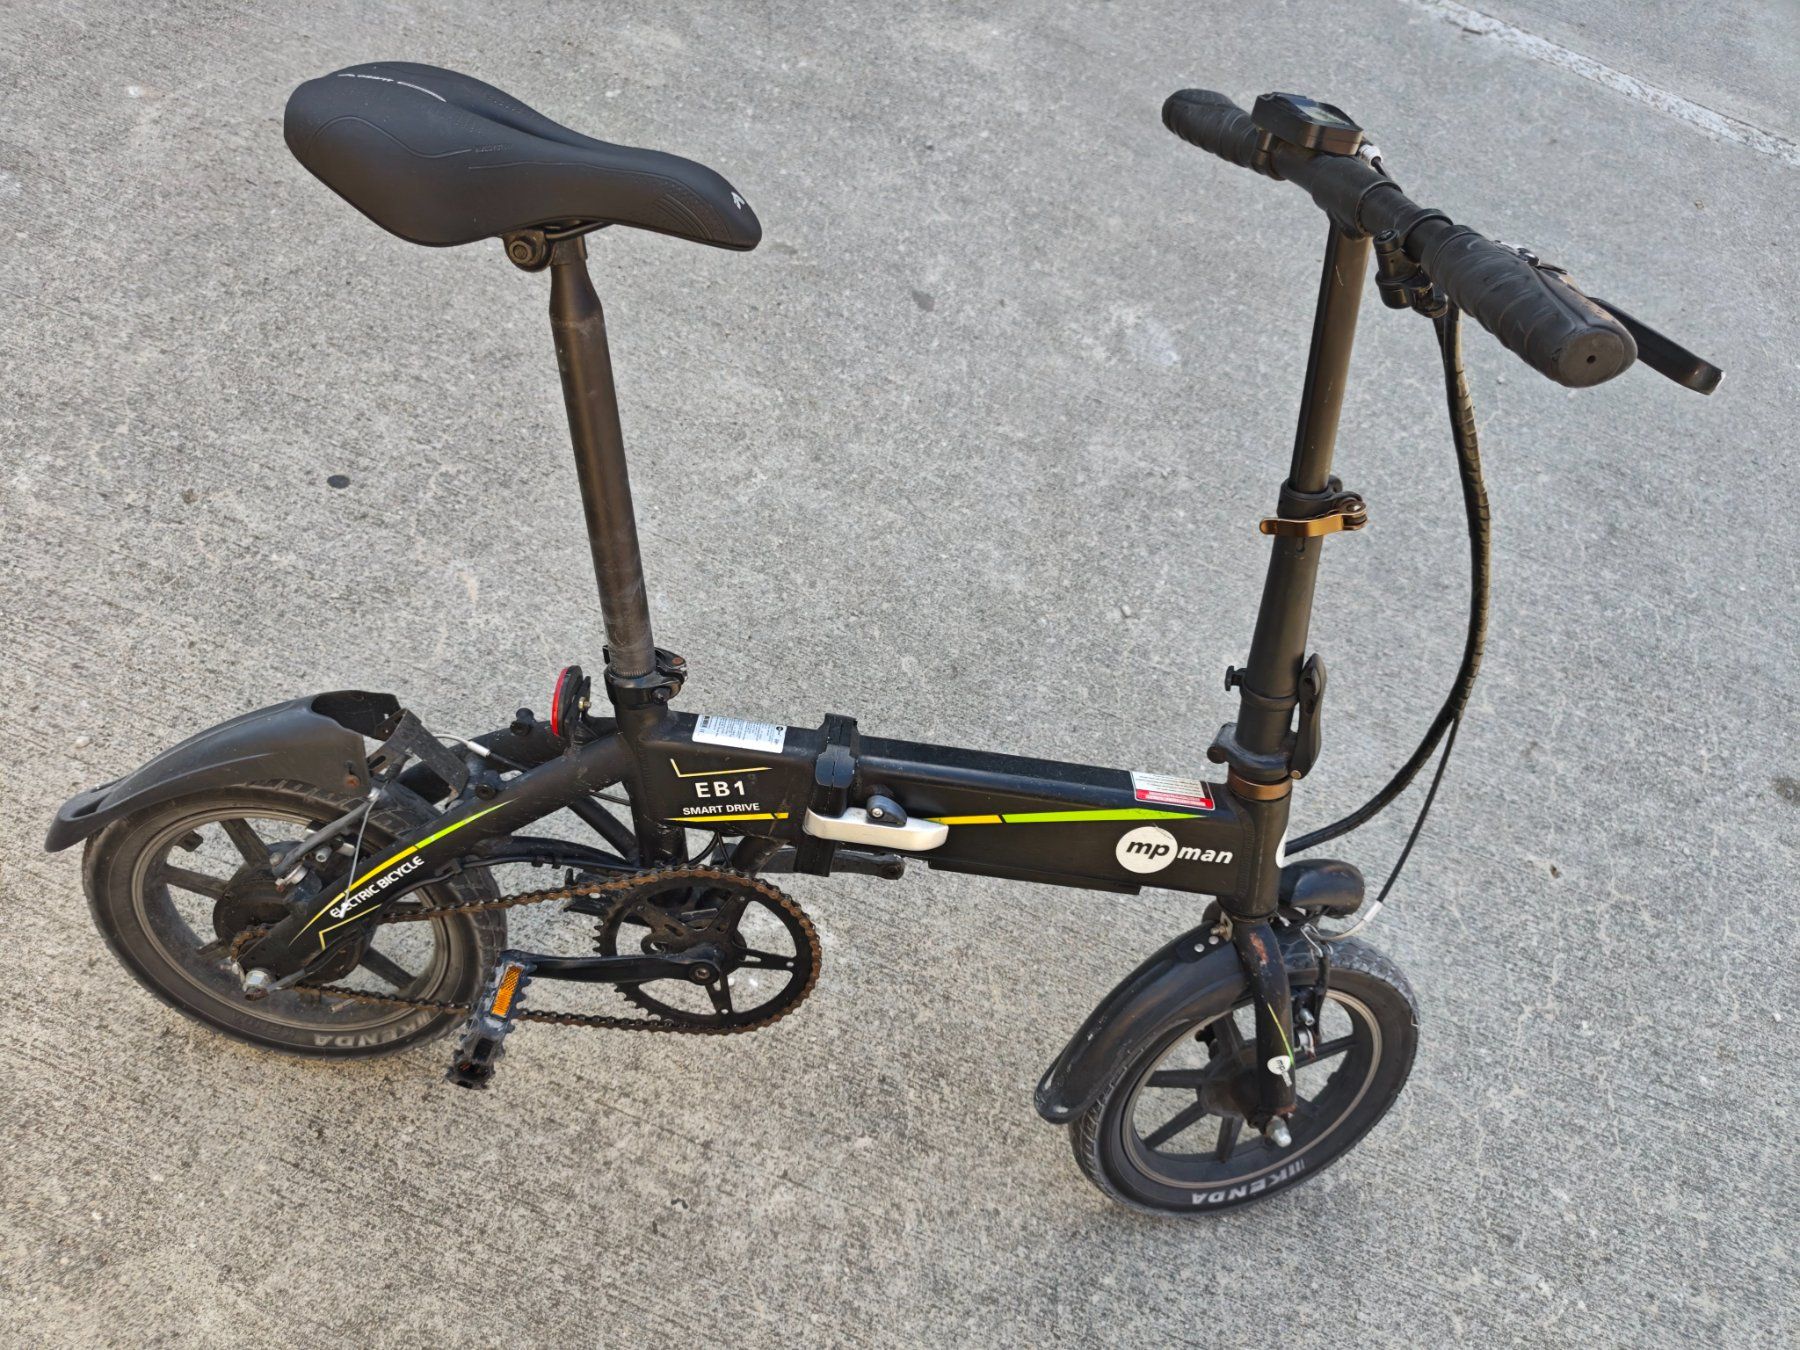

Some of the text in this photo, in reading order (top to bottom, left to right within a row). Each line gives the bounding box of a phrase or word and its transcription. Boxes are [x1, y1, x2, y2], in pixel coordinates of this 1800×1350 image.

[694, 780, 746, 798] EB1
[682, 802, 761, 816] SMART DRIVE
[376, 855, 425, 890] BICYCLE
[1190, 1170, 1289, 1205] KENDA
